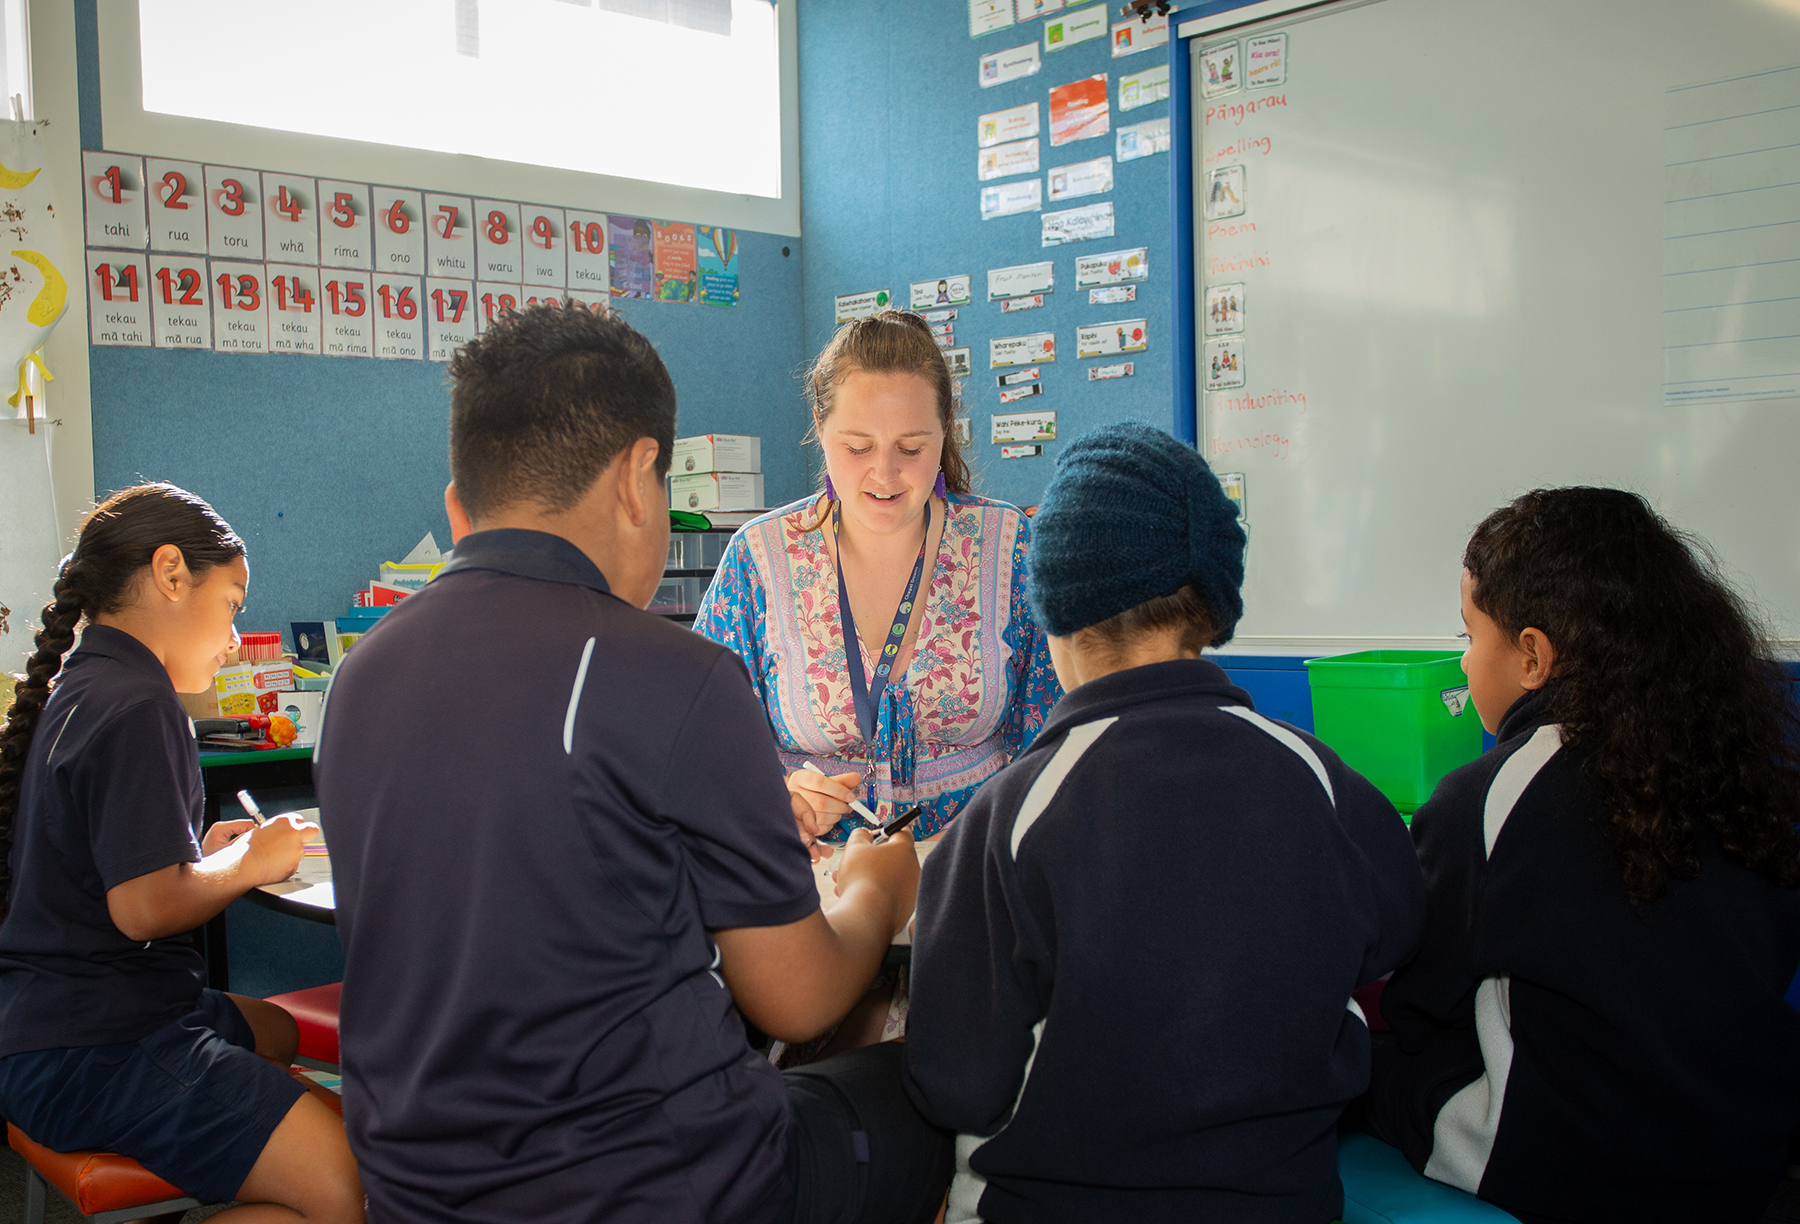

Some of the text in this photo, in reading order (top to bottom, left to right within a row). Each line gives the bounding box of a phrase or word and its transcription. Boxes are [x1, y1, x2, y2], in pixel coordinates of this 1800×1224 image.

[1205, 94, 1288, 126] Pāngarau
[1206, 137, 1272, 162] Spelling
[105, 165, 122, 204] 1
[162, 171, 189, 210] 2
[221, 178, 245, 216] 3
[278, 185, 302, 222] 4
[333, 192, 355, 228] 5
[388, 199, 410, 234] 6
[439, 205, 459, 239] 7
[488, 210, 509, 245] 8
[104, 223, 130, 238] tahi
[168, 230, 189, 242] rua
[533, 215, 552, 249] 9
[657, 231, 692, 243] BOOKS
[1208, 222, 1256, 242] Poem
[223, 235, 249, 248] toru
[569, 220, 605, 255] 10
[279, 239, 304, 253] whā
[334, 245, 359, 258] rima
[390, 253, 411, 263] ono
[437, 256, 466, 269] whitu
[488, 262, 513, 273] waru
[536, 265, 553, 277] iwa
[576, 269, 602, 281] tekau
[95, 263, 139, 302] 11
[155, 267, 203, 306] 12
[216, 273, 261, 311] 13
[272, 275, 315, 313] 14
[325, 280, 366, 317] 15
[377, 284, 417, 320] 16
[430, 288, 468, 323] 17
[105, 313, 137, 324] tekau
[167, 316, 198, 327] tekau
[228, 321, 255, 332] tekau
[281, 322, 308, 333] tekau
[335, 327, 361, 337] tekau
[101, 330, 143, 342] mā tahi
[165, 334, 203, 345] mā rua
[386, 329, 412, 340] tekau
[440, 333, 464, 343] tekau
[222, 338, 262, 350] mā toru
[276, 339, 292, 349] mā
[329, 343, 367, 353] mā rima
[994, 339, 1027, 351] Wharepaku
[382, 346, 416, 356] mā ono
[432, 350, 446, 358] mā
[1209, 388, 1307, 415] Handwriting
[1210, 429, 1289, 460] Technology
